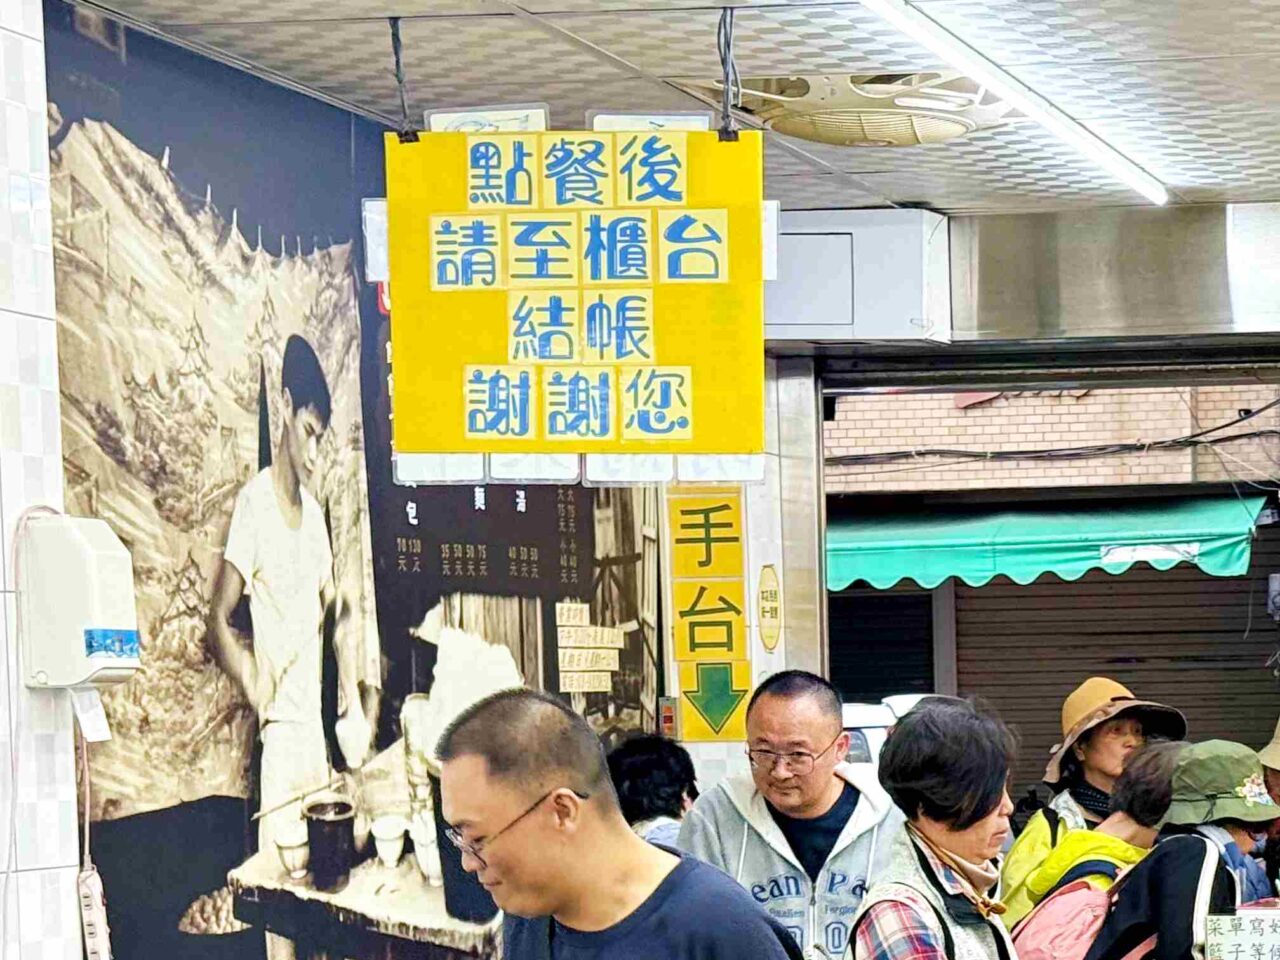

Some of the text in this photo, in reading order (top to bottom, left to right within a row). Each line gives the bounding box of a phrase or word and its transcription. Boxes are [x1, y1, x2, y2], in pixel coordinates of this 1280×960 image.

[469, 135, 683, 206] 點餐後
[434, 214, 722, 287] 請至櫃台
[512, 293, 651, 360] 結帳
[467, 367, 690, 436] 謝謝您
[674, 503, 743, 654] 手台
[751, 872, 869, 903] ean Pa
